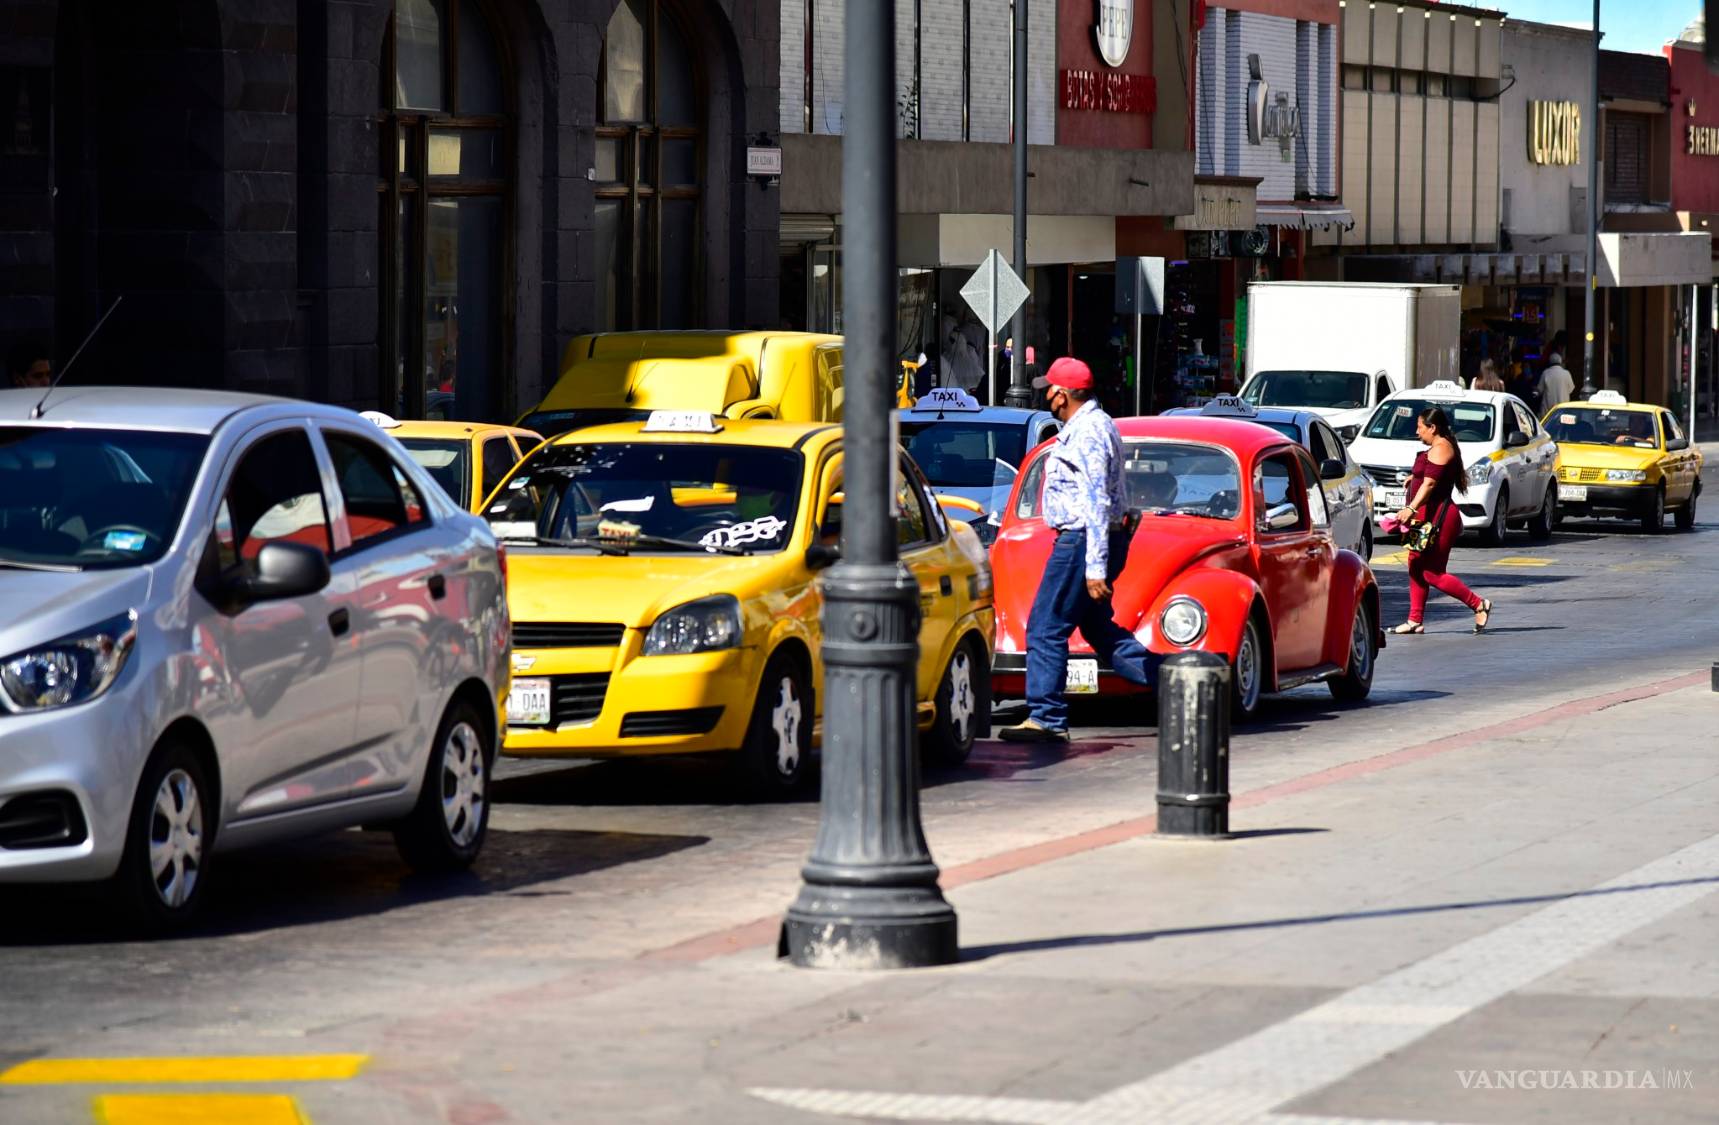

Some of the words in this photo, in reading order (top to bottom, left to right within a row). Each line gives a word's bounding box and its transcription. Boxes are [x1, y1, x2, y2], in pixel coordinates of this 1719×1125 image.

[1102, 5, 1127, 39] PEPE
[1067, 69, 1095, 109] BOTAS
[1532, 99, 1581, 166] LUXOR
[931, 391, 958, 402] TAXI
[1435, 383, 1452, 392] TAXI
[1217, 398, 1239, 407] TAXI
